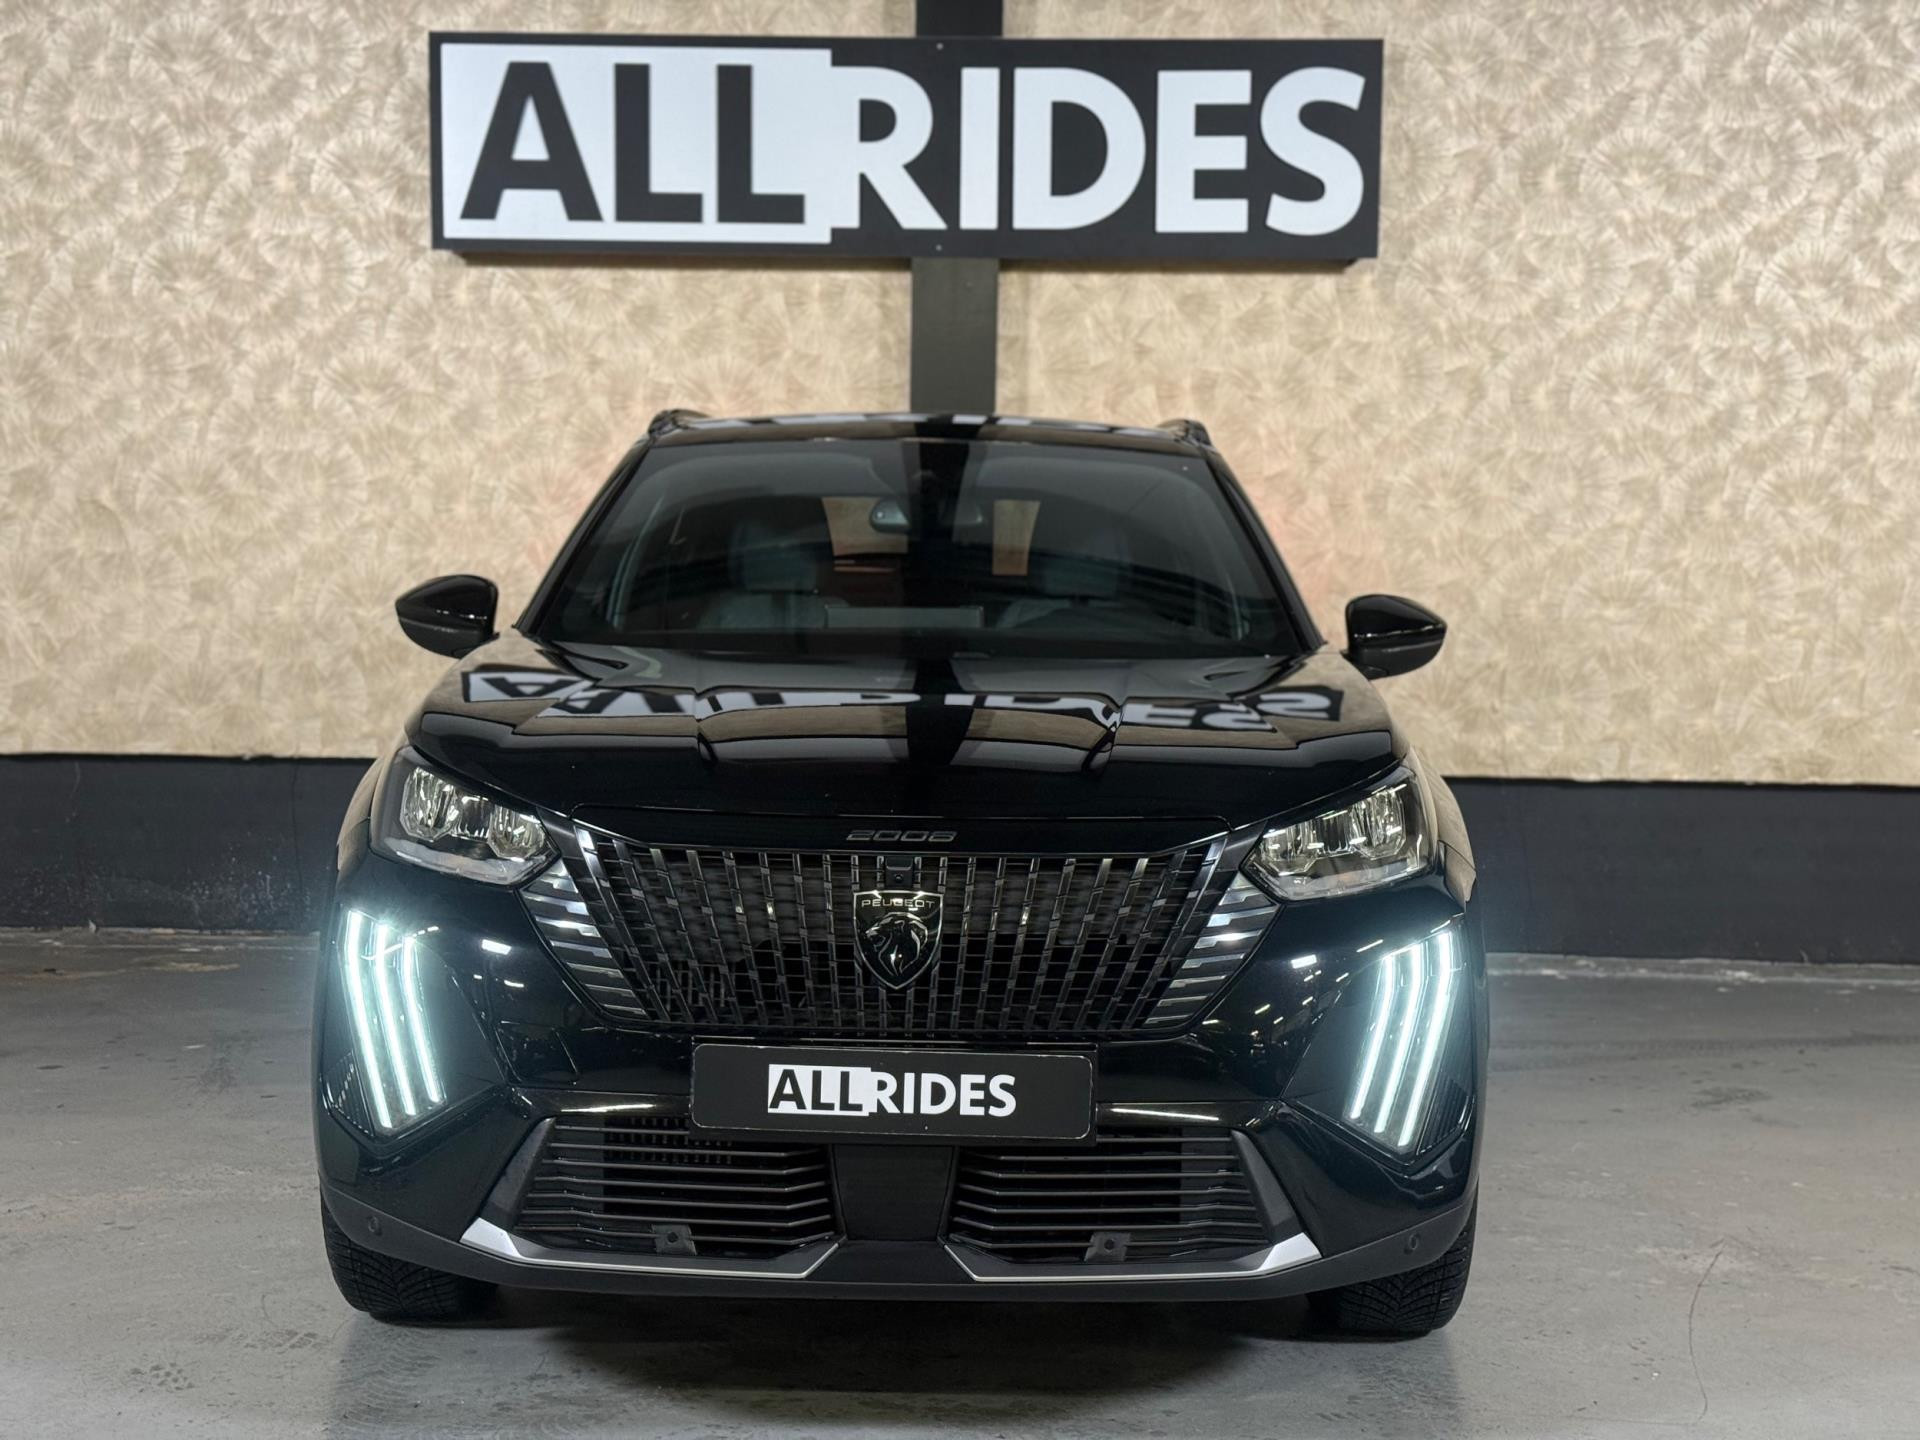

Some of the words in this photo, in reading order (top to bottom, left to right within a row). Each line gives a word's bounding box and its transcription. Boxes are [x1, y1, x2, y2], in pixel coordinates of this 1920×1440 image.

[460, 62, 1366, 235] ALLRIDES
[846, 829, 957, 842] 2008
[861, 898, 935, 908] PEUGEOT
[769, 1068, 1017, 1117] ALLRIDES
